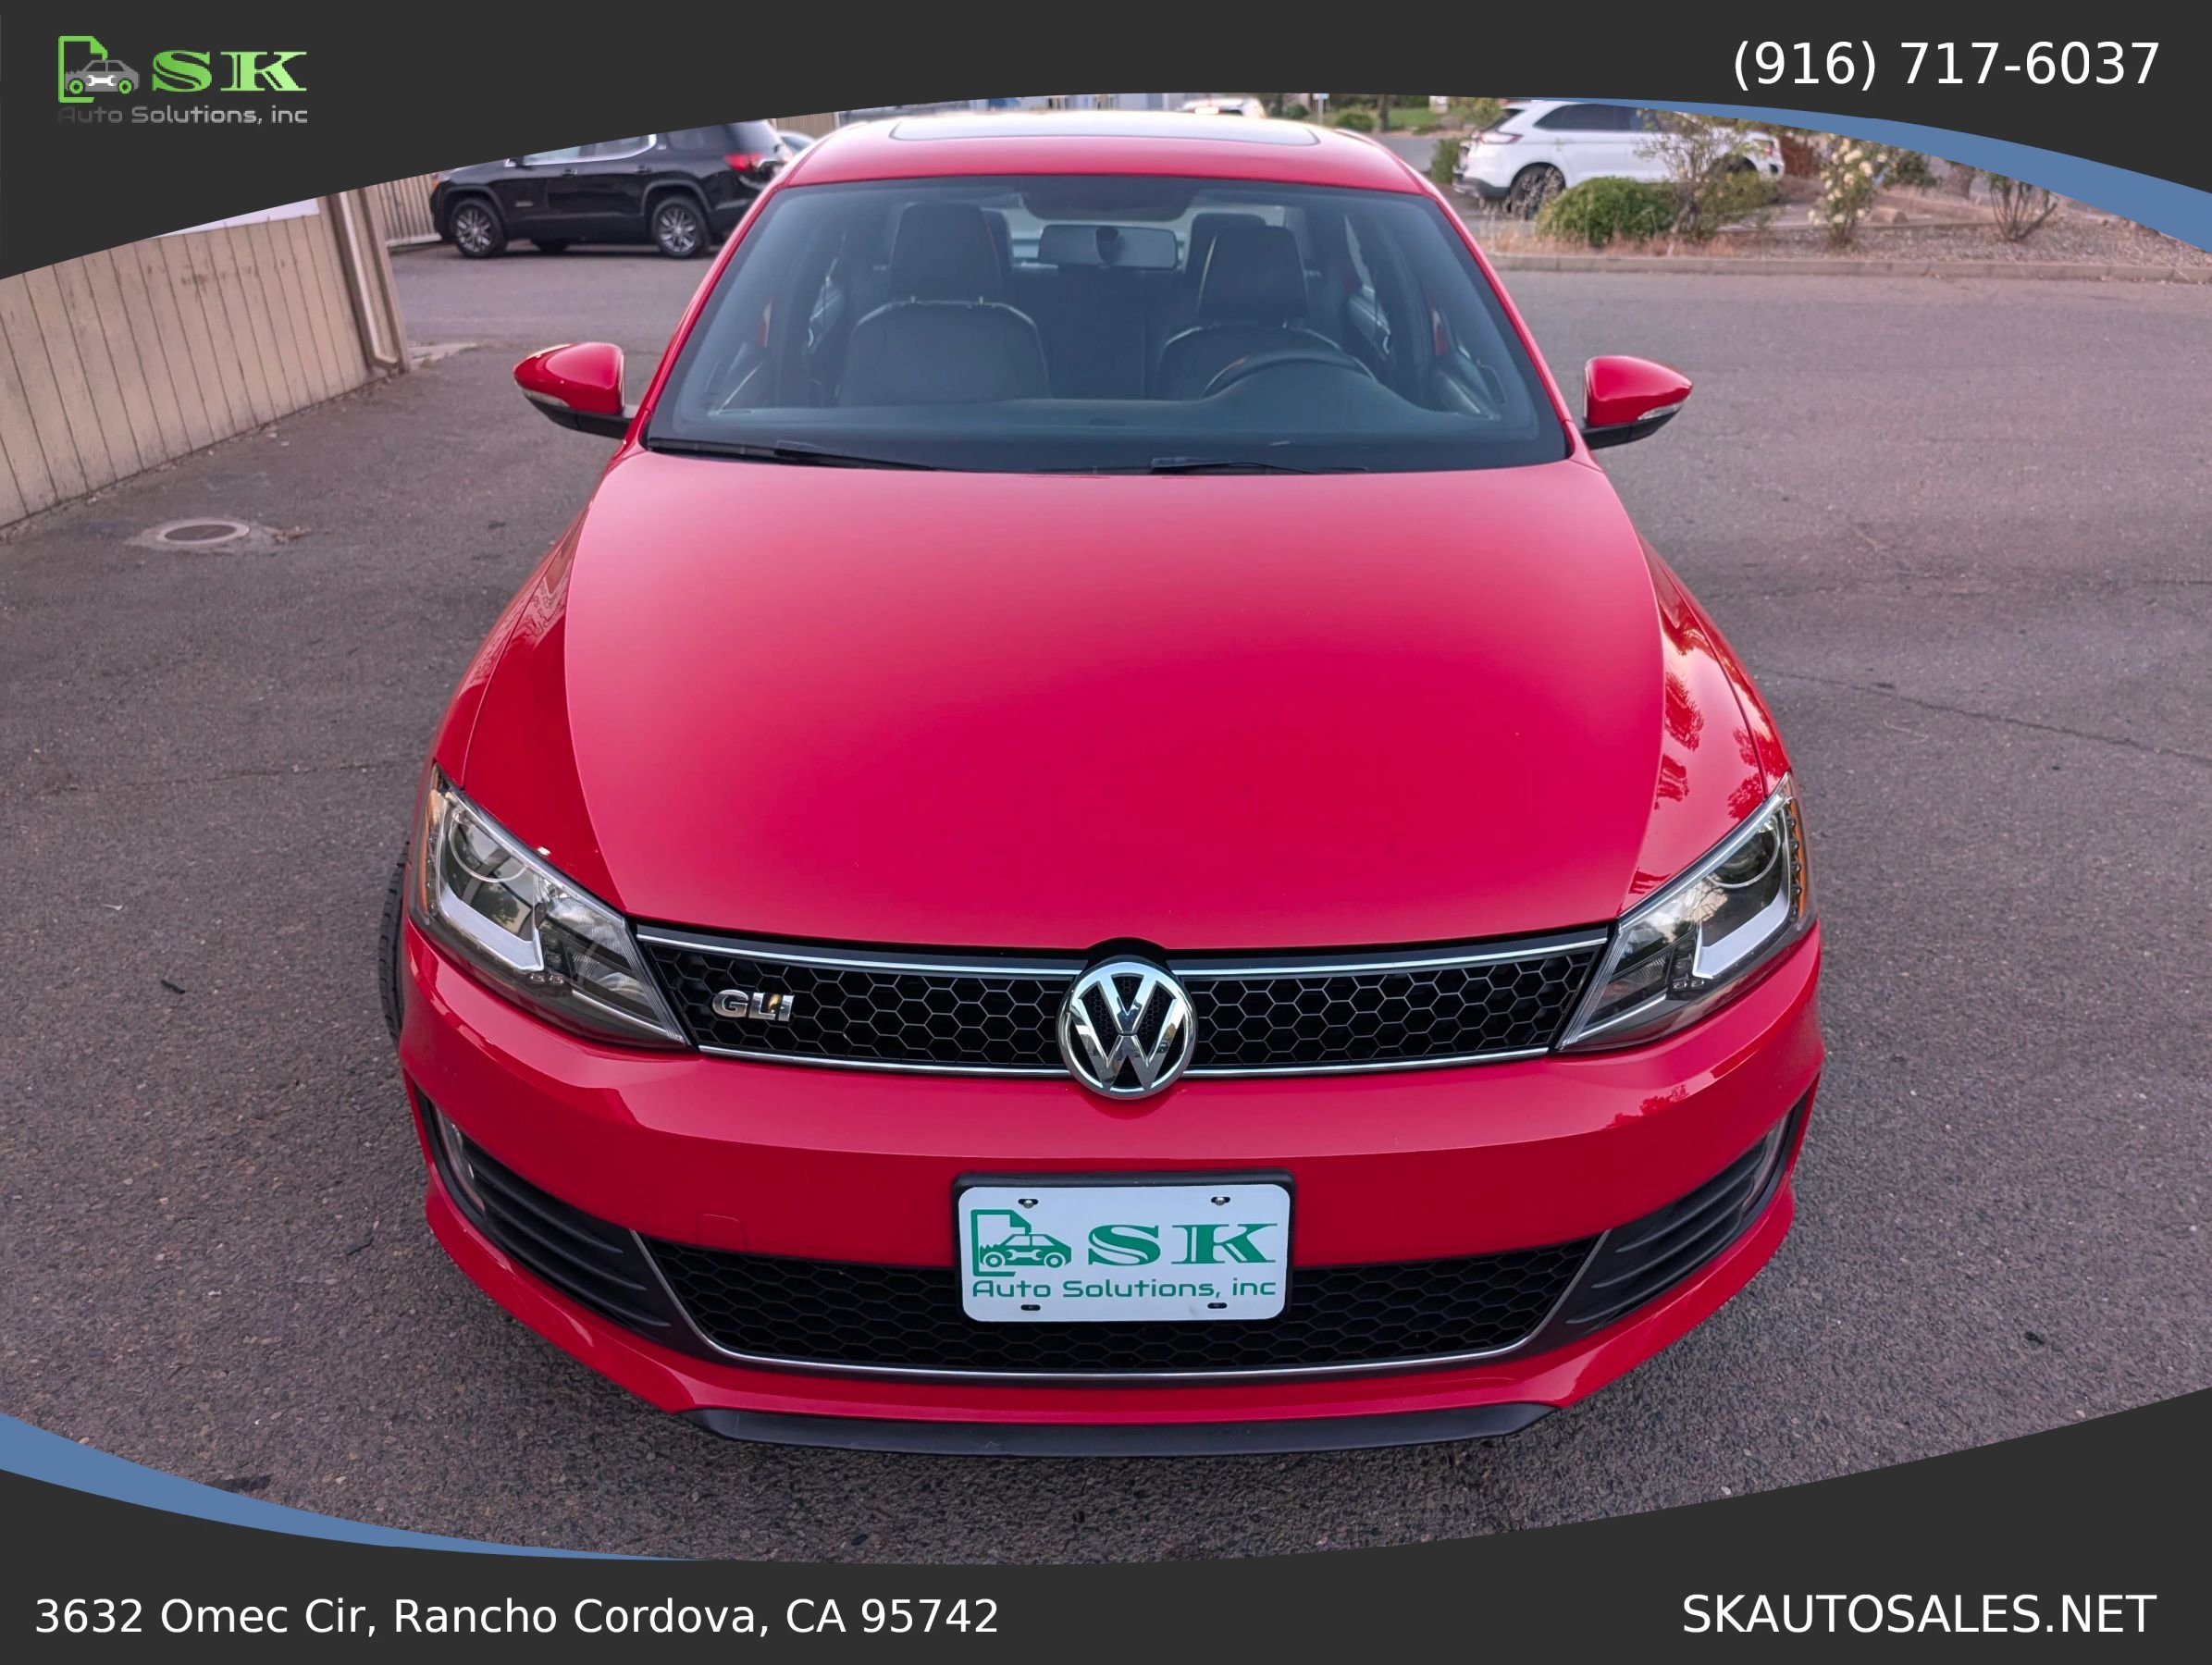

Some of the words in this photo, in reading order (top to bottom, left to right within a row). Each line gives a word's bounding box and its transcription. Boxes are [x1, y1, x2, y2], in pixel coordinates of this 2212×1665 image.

[712, 989, 795, 1022] GLI
[1088, 1223, 1278, 1266] SK
[972, 1279, 1052, 1299] Auto
[1062, 1277, 1220, 1300] Solutions,
[1232, 1276, 1277, 1296] inc
